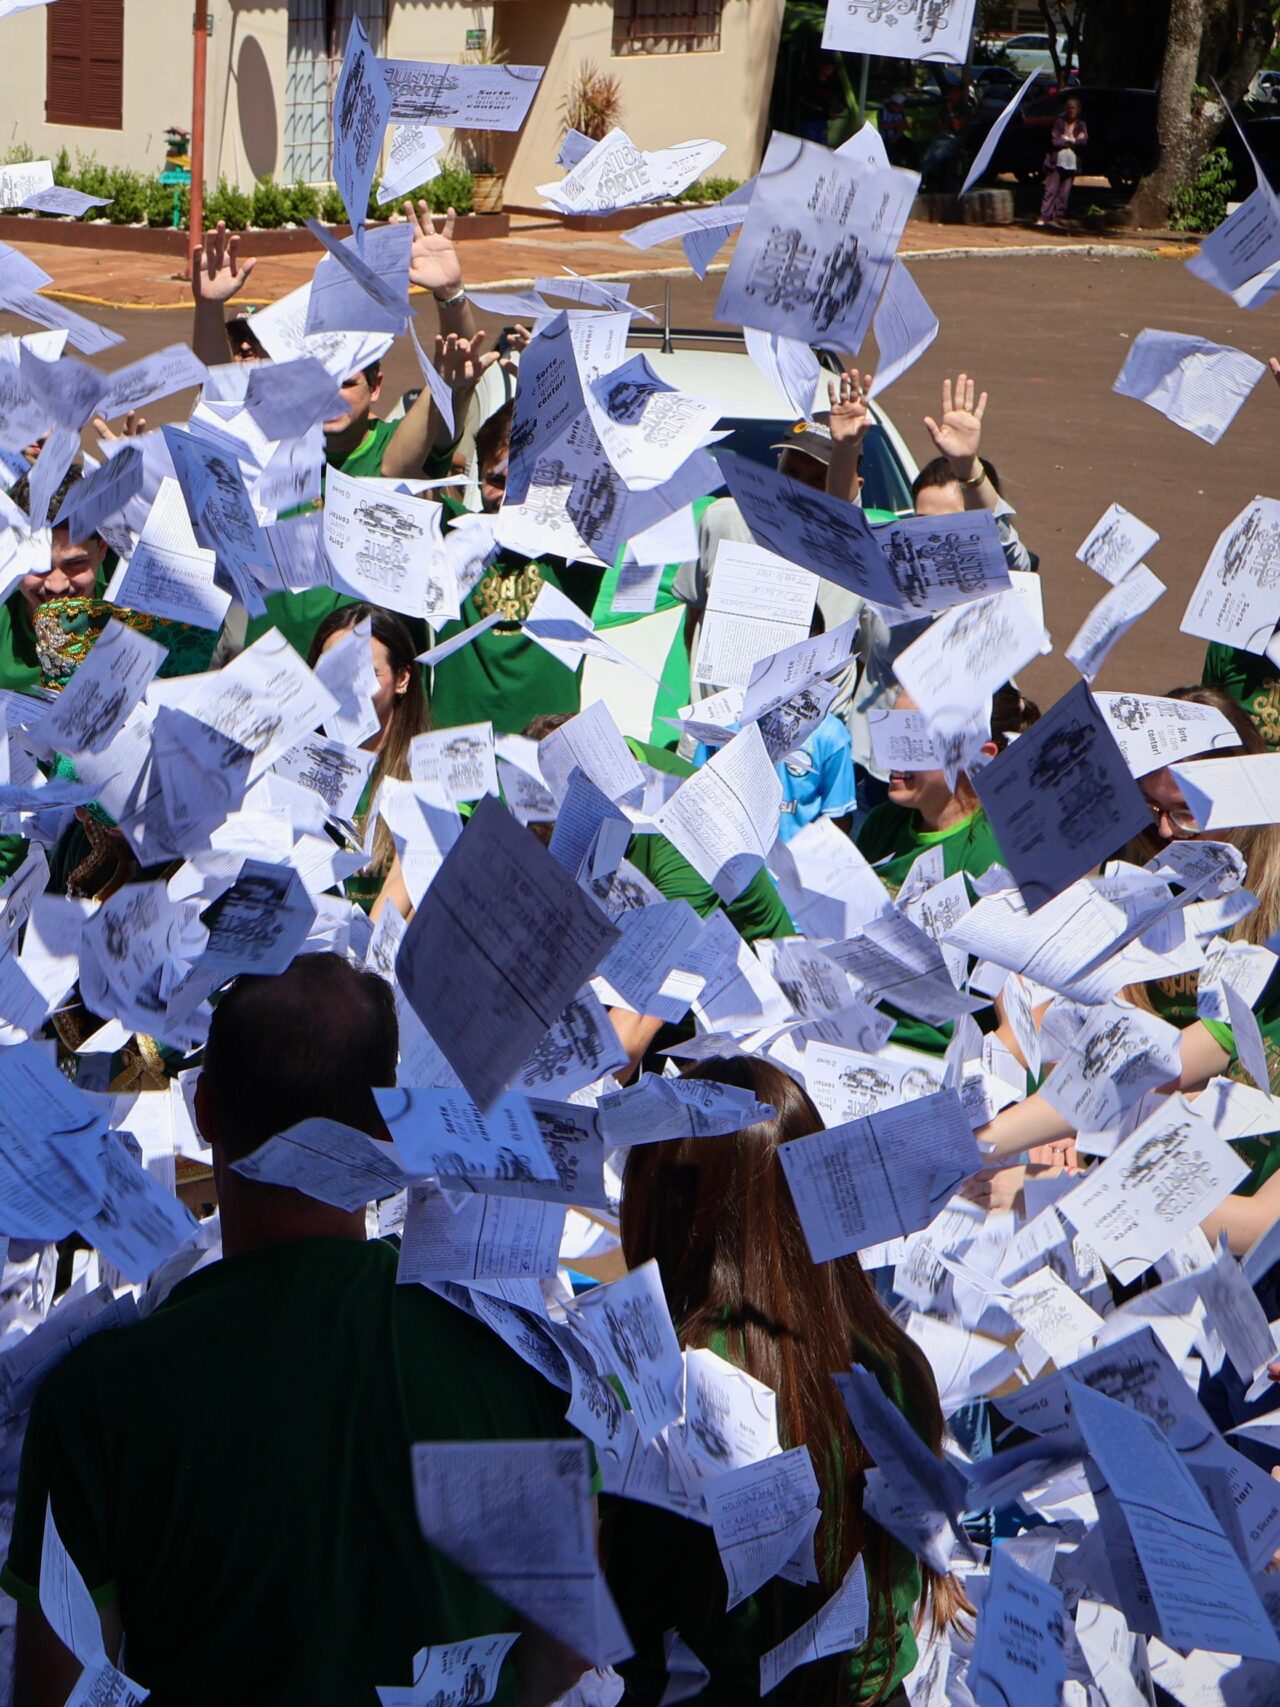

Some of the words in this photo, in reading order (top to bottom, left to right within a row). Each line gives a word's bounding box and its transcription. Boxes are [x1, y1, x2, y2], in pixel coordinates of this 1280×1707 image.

[535, 357, 558, 383] Sorte
[536, 374, 567, 409] contar!
[1146, 728, 1161, 756] contar!
[1257, 1507, 1280, 1534] Sicredi
